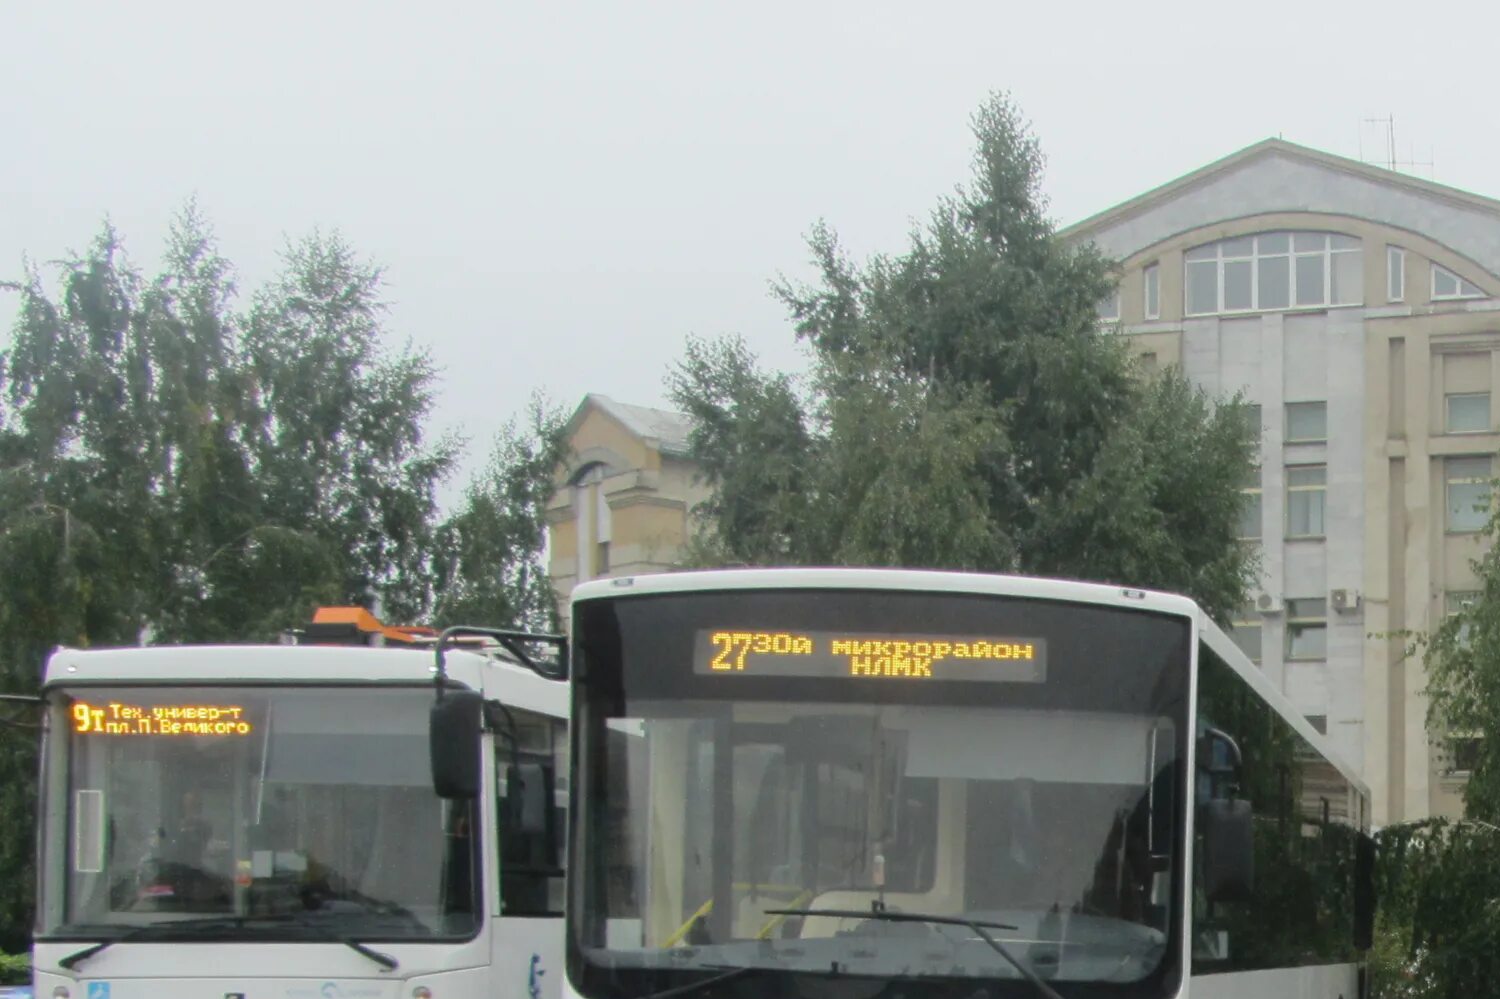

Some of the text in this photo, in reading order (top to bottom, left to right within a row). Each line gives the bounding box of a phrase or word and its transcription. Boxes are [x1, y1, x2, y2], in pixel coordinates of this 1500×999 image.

[712, 632, 752, 671] 27
[832, 640, 1033, 660] микрорайон
[852, 656, 932, 677] НЛМК
